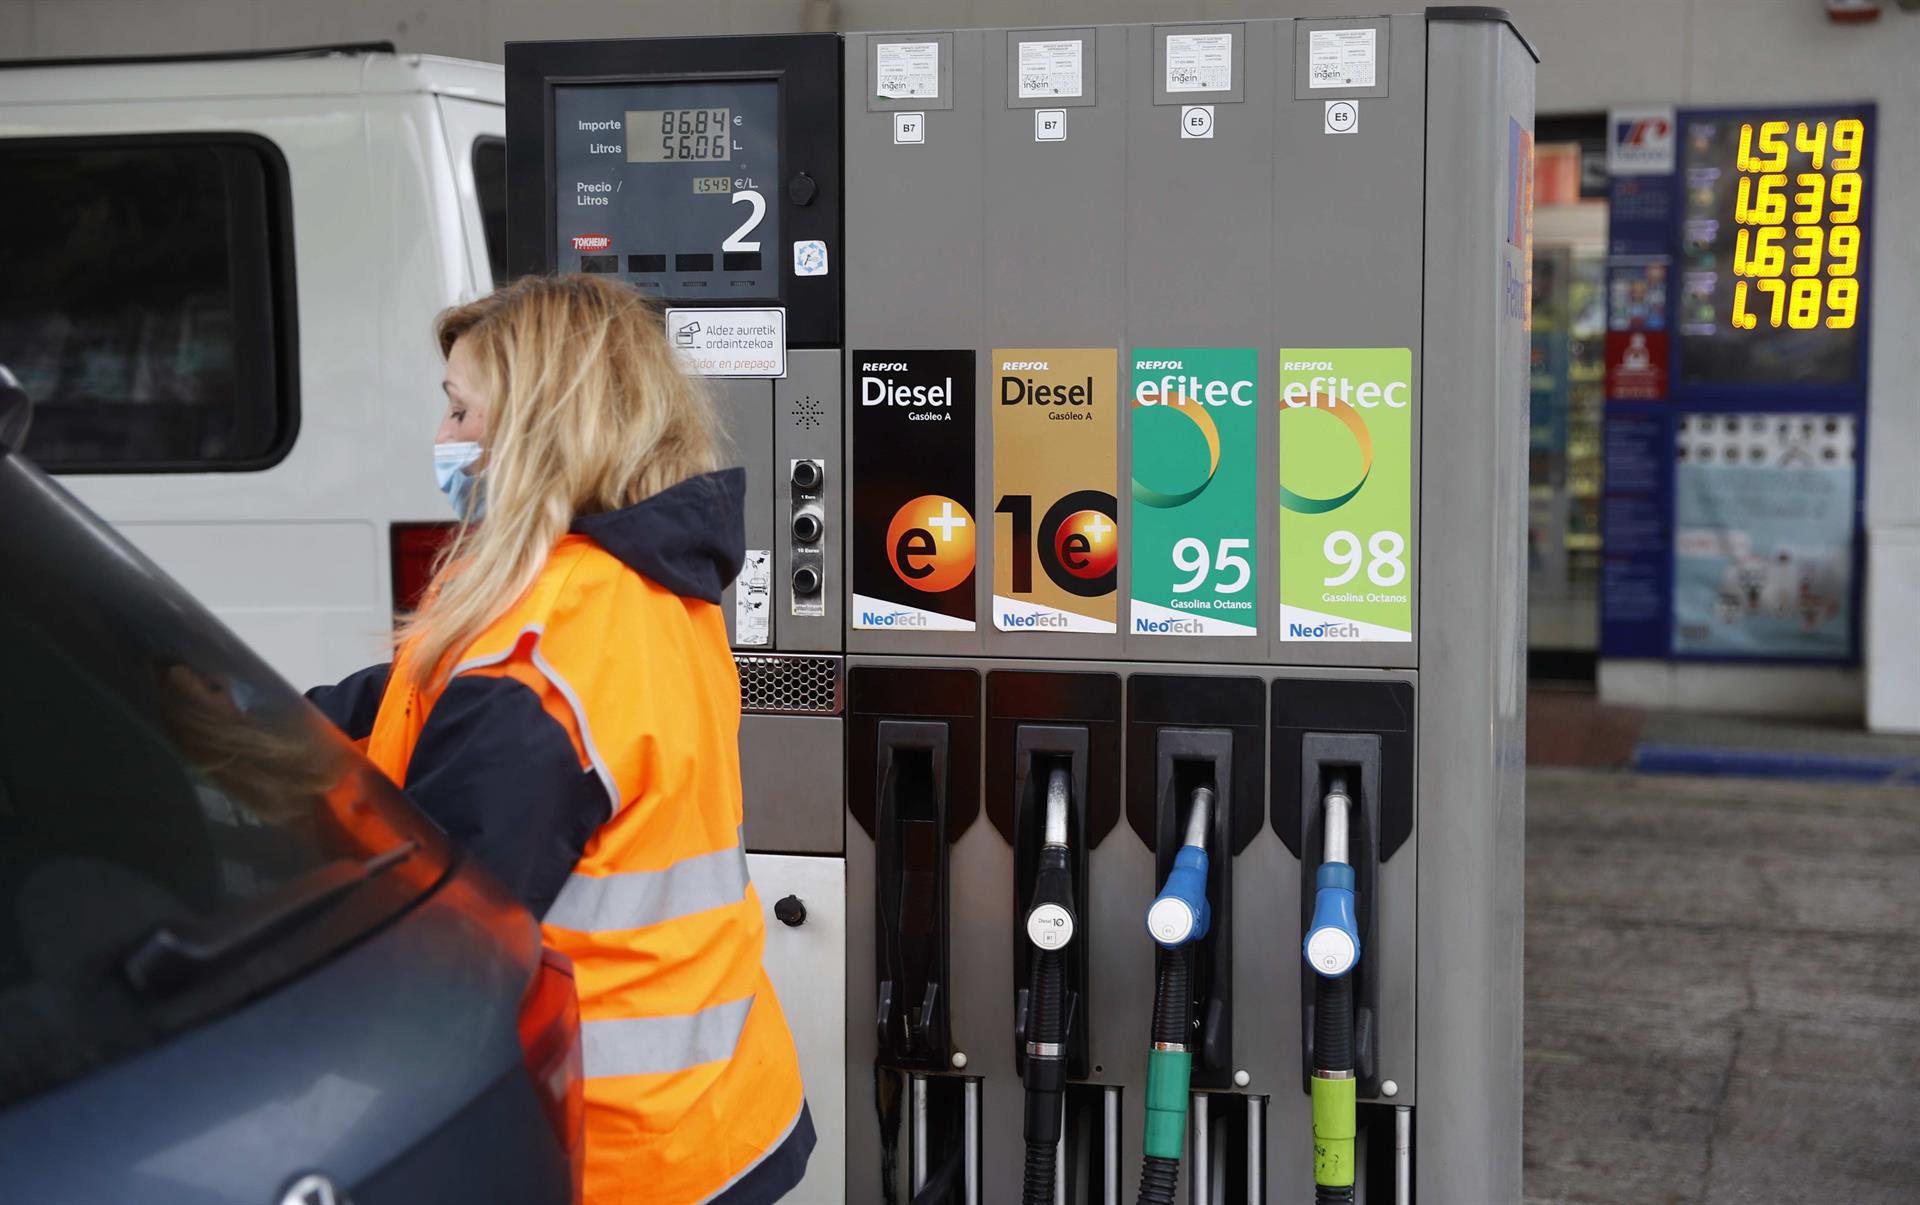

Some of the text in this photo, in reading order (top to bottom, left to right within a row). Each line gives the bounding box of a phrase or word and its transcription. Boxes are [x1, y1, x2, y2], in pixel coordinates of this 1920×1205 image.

[1191, 117, 1204, 126] E5
[1334, 112, 1348, 122] E5
[578, 120, 622, 132] Importe
[903, 124, 916, 133] B7
[1044, 121, 1057, 130] B7
[590, 143, 622, 154] Litros
[577, 182, 612, 192] Precio
[577, 195, 609, 206] Litros
[721, 190, 766, 252] 2
[572, 237, 608, 249] TOKHEIM
[706, 325, 776, 336] Aldez aurretik
[706, 338, 774, 349] ordaintzekoa
[718, 361, 732, 369] en
[734, 360, 776, 371] prepago
[862, 362, 909, 372] REPSOL
[1002, 361, 1049, 371] REPSOL
[1136, 360, 1184, 370] REPSOL
[1284, 361, 1334, 371] REPSOL
[862, 376, 952, 407] Diesel
[1001, 376, 1093, 406] Diesel
[1135, 375, 1254, 407] efitec
[1283, 376, 1408, 408] efitec
[908, 411, 952, 421] Gasóleo A
[1048, 411, 1092, 421] Gasóleo A
[1323, 530, 1406, 587] 98
[1172, 537, 1251, 594] 95
[1322, 592, 1407, 603] Gasolina Octanos
[1170, 599, 1252, 609] Gasolina Octanos
[862, 611, 927, 626] NeoTech
[1003, 611, 1068, 627] NeoTech
[1136, 617, 1204, 633] NeoTech
[1289, 622, 1360, 638] NeoTech
